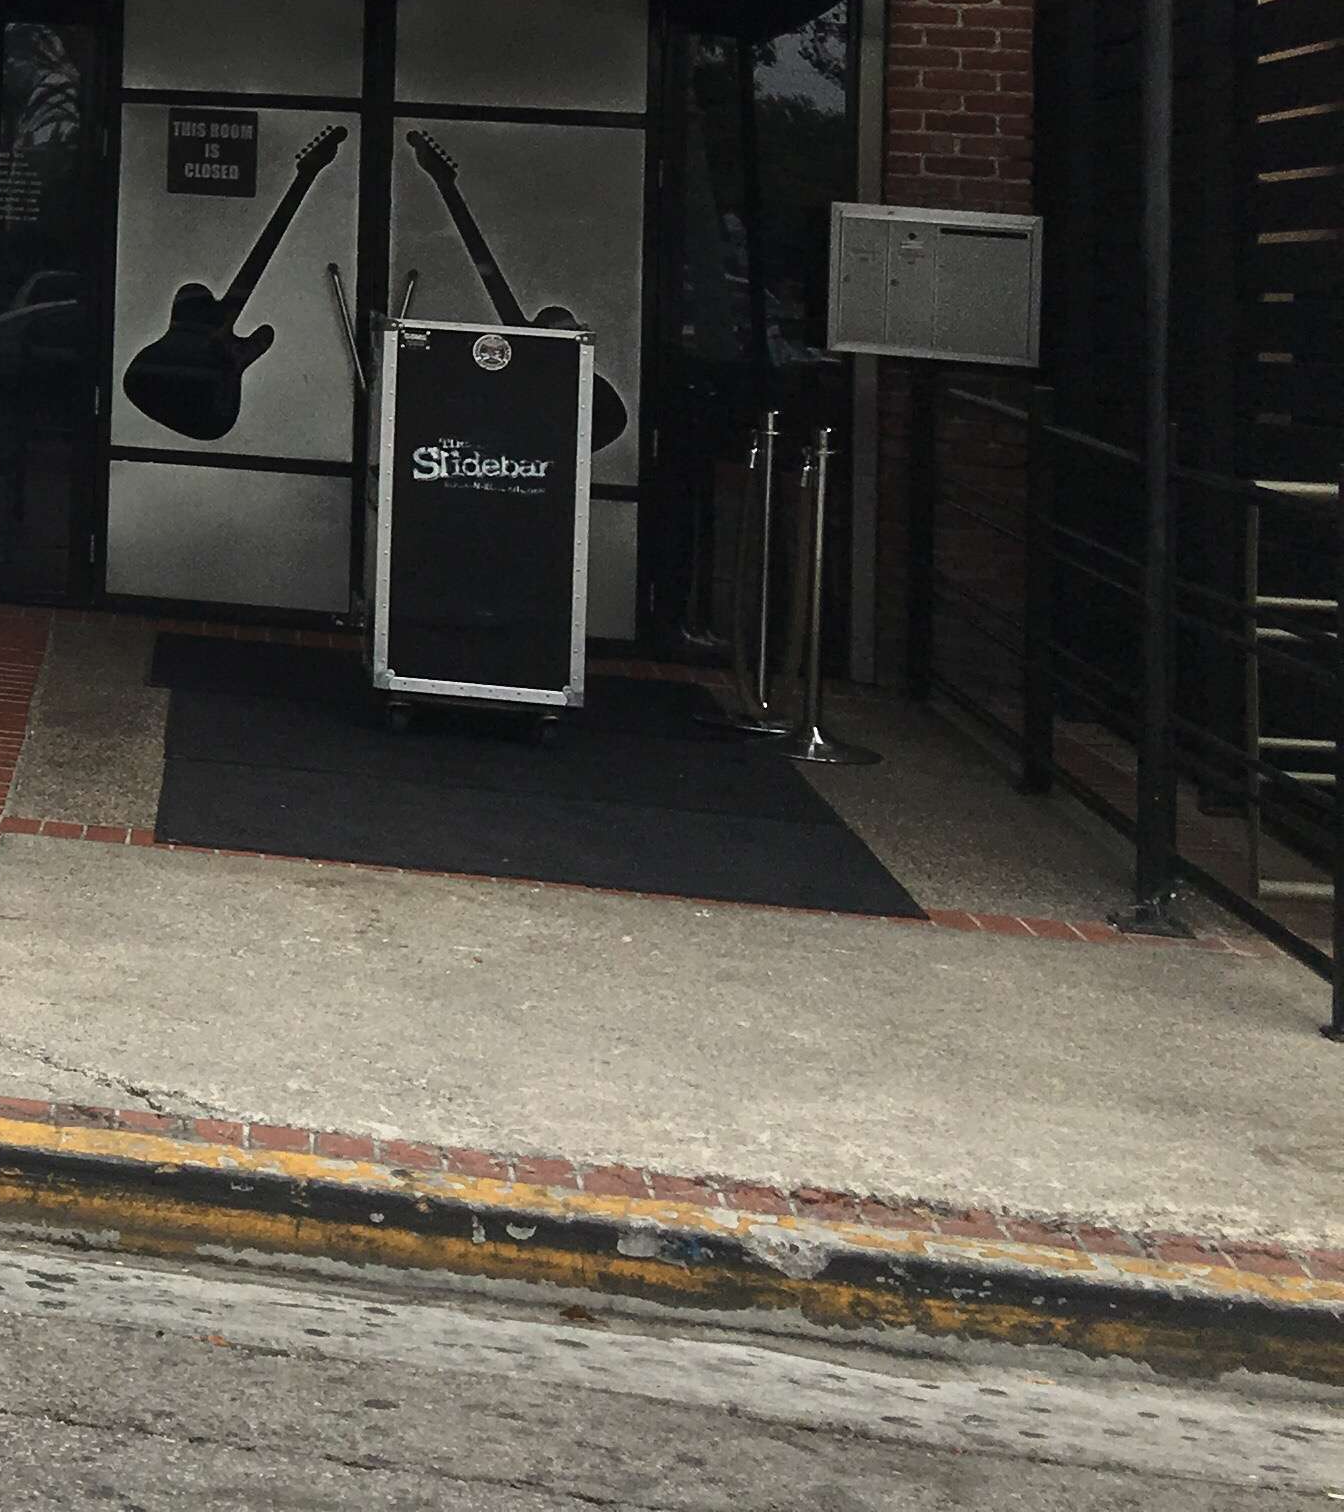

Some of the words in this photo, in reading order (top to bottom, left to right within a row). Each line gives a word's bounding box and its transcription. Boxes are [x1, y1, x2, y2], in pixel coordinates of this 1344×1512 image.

[173, 121, 207, 139] THIS
[209, 122, 254, 140] ROOM
[204, 143, 221, 159] IS
[184, 162, 240, 180] CLOSED
[412, 445, 552, 482] Slidebar
